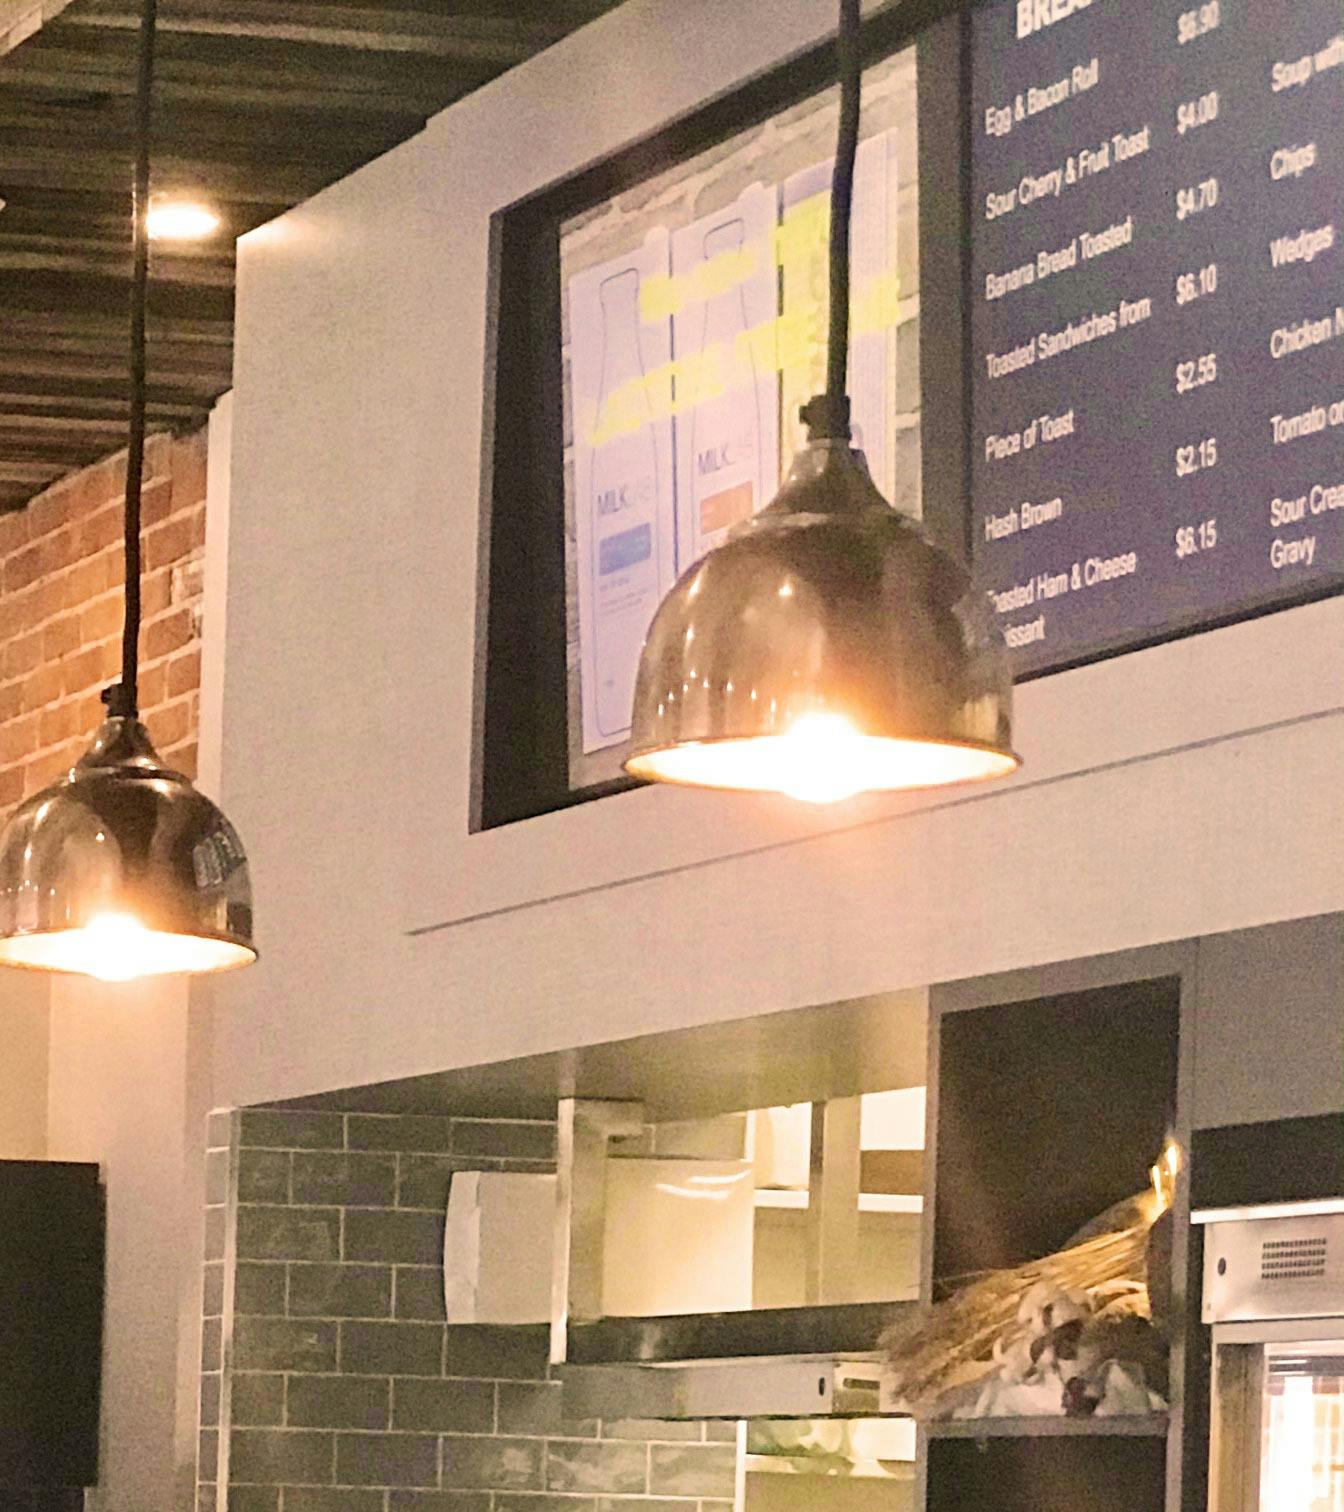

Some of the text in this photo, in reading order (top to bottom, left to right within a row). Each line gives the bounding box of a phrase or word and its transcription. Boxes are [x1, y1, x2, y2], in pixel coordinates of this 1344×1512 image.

[1271, 55, 1312, 92] Soup
[985, 57, 1100, 136] Egg & Bacon Roll
[1176, 91, 1218, 135] $4.00
[985, 125, 1151, 220] Sour Cherry & Fruit Toast
[1270, 144, 1317, 181] Chips
[1176, 177, 1218, 221] $4.70
[985, 215, 1133, 301] Banana Bread Toasted
[1270, 224, 1335, 268] Wedges
[986, 298, 1152, 379] Toasted Sandwiches from
[1270, 316, 1332, 359] Chicken
[1176, 353, 1217, 394] $2.55
[985, 410, 1075, 462] Piece of Toast
[1270, 405, 1326, 444] Tomato
[1176, 437, 1217, 478] $2.15
[985, 497, 1063, 541] Hash Brown
[1270, 495, 1307, 527] Sour
[1175, 517, 1217, 560] $6.15
[1270, 536, 1316, 569] Gravy
[1037, 573, 1068, 600] Ham
[1071, 562, 1082, 591] &
[1084, 551, 1137, 586] Cheese
